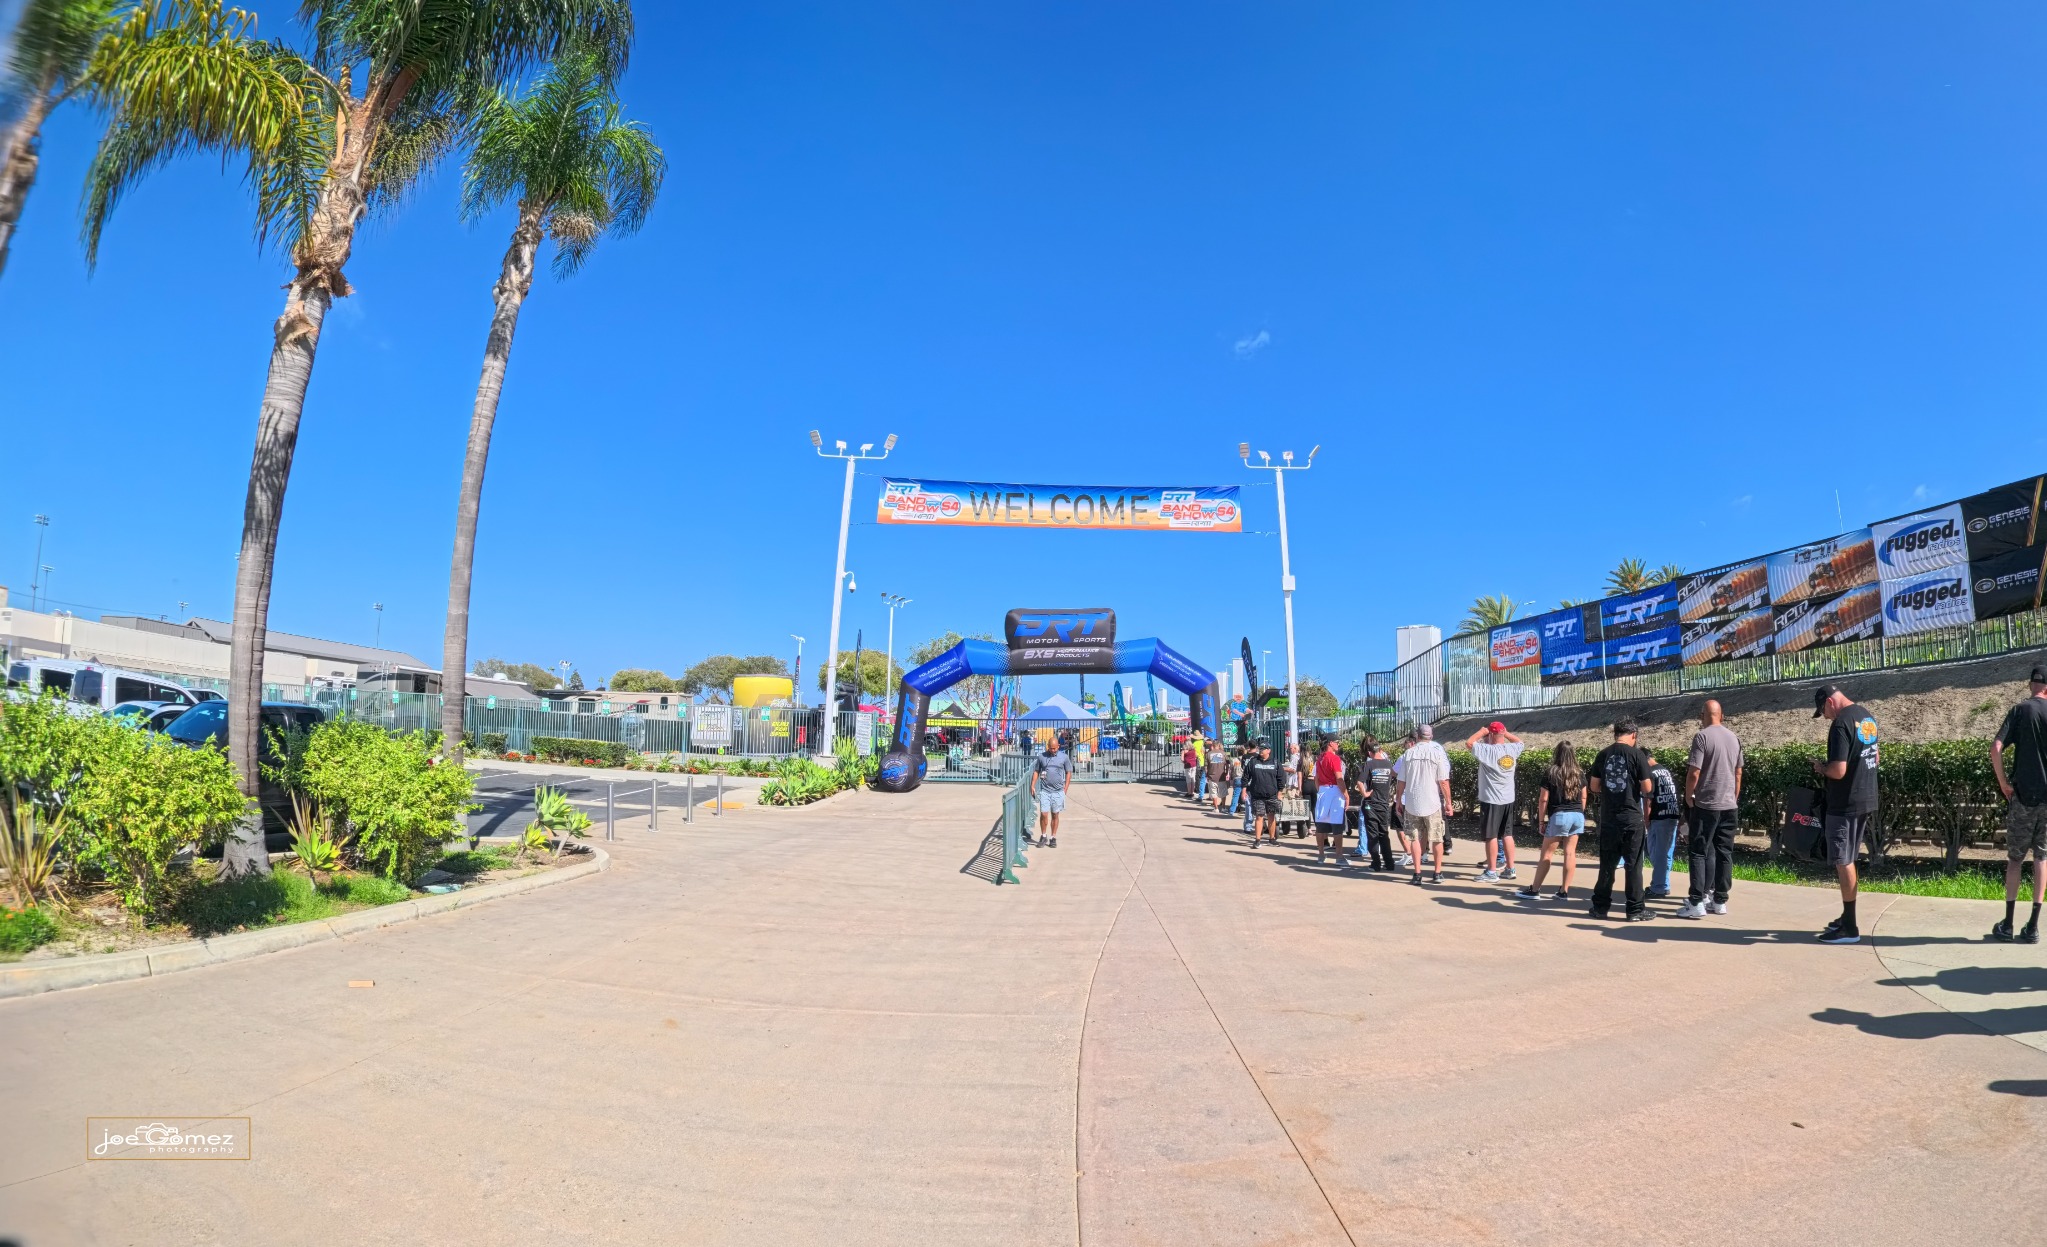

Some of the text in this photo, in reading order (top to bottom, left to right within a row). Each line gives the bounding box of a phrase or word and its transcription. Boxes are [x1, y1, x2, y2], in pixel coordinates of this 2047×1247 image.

[886, 495, 927, 505] SAND
[941, 501, 959, 511] S4
[969, 490, 1150, 525] WELCOME
[897, 503, 939, 513] SHOW
[1162, 504, 1202, 512] SAND
[1173, 511, 1215, 520] SHOW
[1217, 506, 1235, 516] S4
[1988, 506, 2030, 523] GENESIS
[1989, 514, 2032, 529] SUPREME
[1927, 537, 1961, 552] radios
[1996, 568, 2039, 585] GENESIS
[1996, 576, 2040, 590] SUPREME
[1614, 594, 1665, 624] DRT
[1934, 596, 1968, 611] radios
[1774, 600, 1809, 632] RPM
[1014, 612, 1110, 643] DRT
[1493, 629, 1511, 640] DRT
[1545, 618, 1578, 638] DRT
[1493, 639, 1516, 651] SAND
[1499, 645, 1525, 657] SHOW
[1525, 637, 1538, 650] S4
[1616, 637, 1668, 666] DRT
[1551, 651, 1594, 676] DRT
[1647, 658, 1668, 666] SPORTS
[899, 692, 918, 748] DRT
[1200, 693, 1217, 740] DRT
